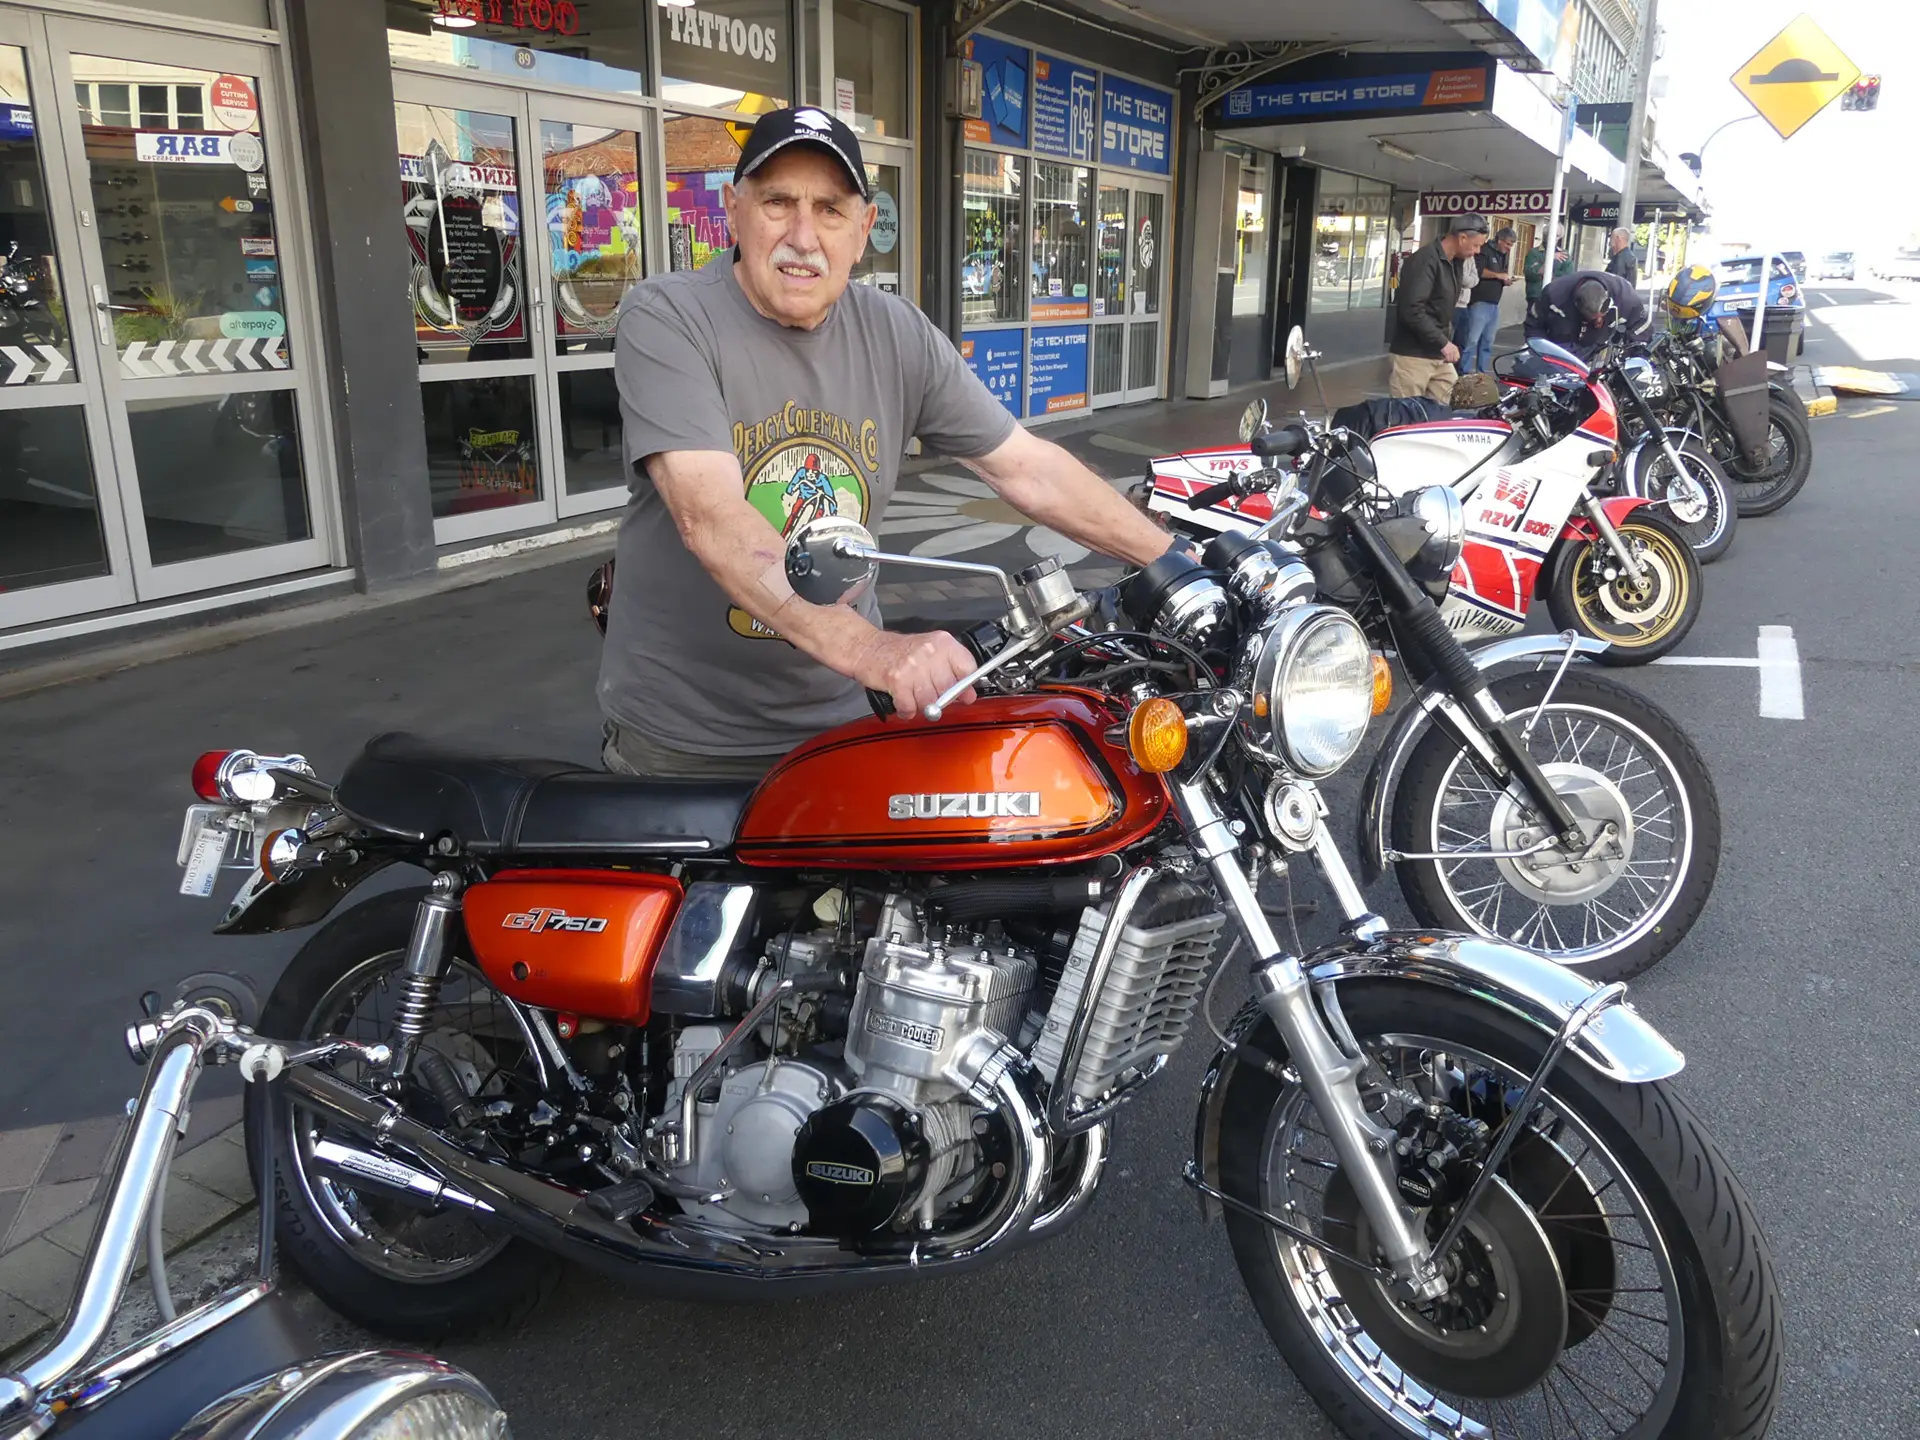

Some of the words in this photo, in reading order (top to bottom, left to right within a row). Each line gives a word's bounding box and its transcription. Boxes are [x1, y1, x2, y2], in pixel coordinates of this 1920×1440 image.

[667, 3, 776, 63] TATTOOS
[518, 54, 532, 65] 89
[221, 91, 248, 99] CUTTING
[221, 99, 248, 107] SERVICE
[1257, 94, 1293, 106] THE
[1299, 90, 1346, 103] TECH
[1353, 84, 1415, 99] STORE
[1105, 90, 1132, 116] THE
[1135, 99, 1166, 125] TECH
[794, 128, 832, 142] SUZUKI
[1104, 120, 1164, 160] STORE
[229, 319, 267, 331] afterpay
[1045, 335, 1063, 347] TECH
[1064, 334, 1087, 345] STORE
[733, 412, 782, 466] PERCY
[784, 400, 853, 443] COLEMAN
[1455, 433, 1492, 445] YAMAHA
[1209, 459, 1249, 472] YPVS
[1480, 509, 1515, 528] RZV
[751, 618, 782, 638] WA
[1468, 609, 1515, 635] YAMAHA
[888, 792, 1041, 819] SUZUKI
[810, 1164, 869, 1182] SUZUKI
